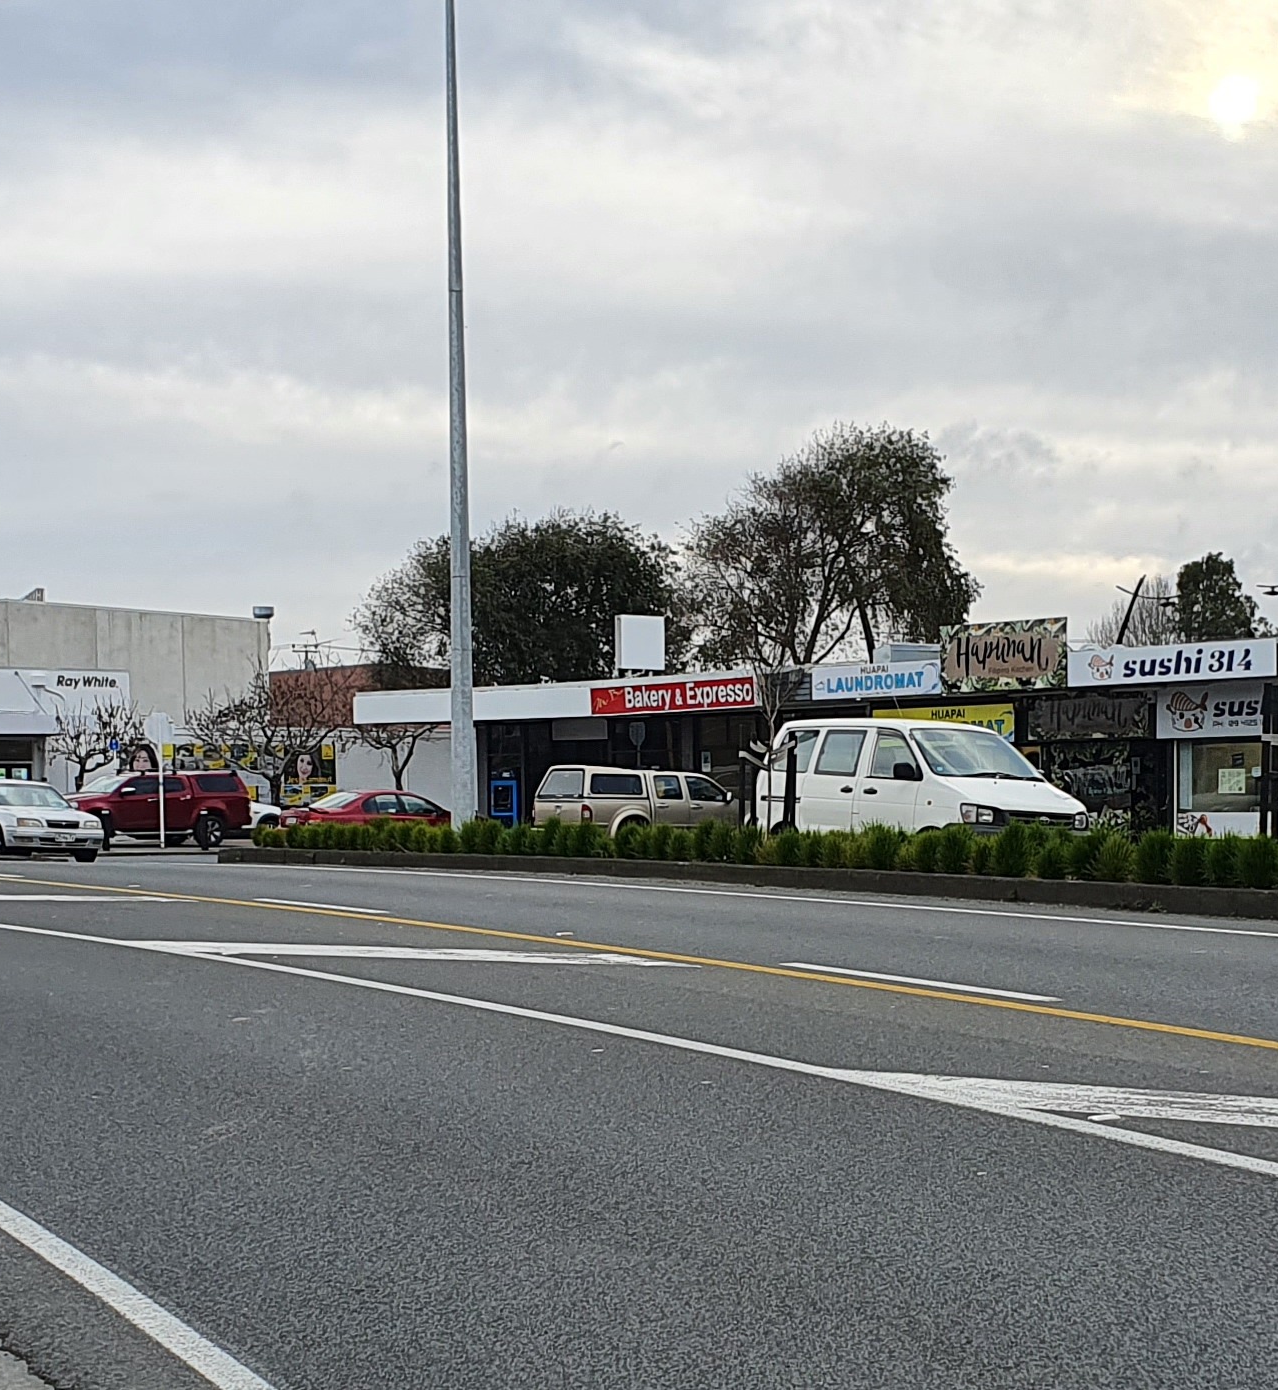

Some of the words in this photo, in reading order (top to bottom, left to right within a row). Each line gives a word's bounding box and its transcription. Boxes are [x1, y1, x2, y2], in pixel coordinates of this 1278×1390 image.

[956, 636, 1049, 678] Hapunan
[1123, 649, 1204, 677] sushi
[1208, 648, 1253, 673] 314
[860, 665, 889, 674] HUAPAI
[56, 675, 81, 690] Ray
[827, 672, 924, 693] LAUNDROMAT
[625, 687, 672, 711] Bakery
[675, 689, 683, 705] &
[685, 683, 752, 708] Expresso
[931, 709, 966, 720] HUAPAI
